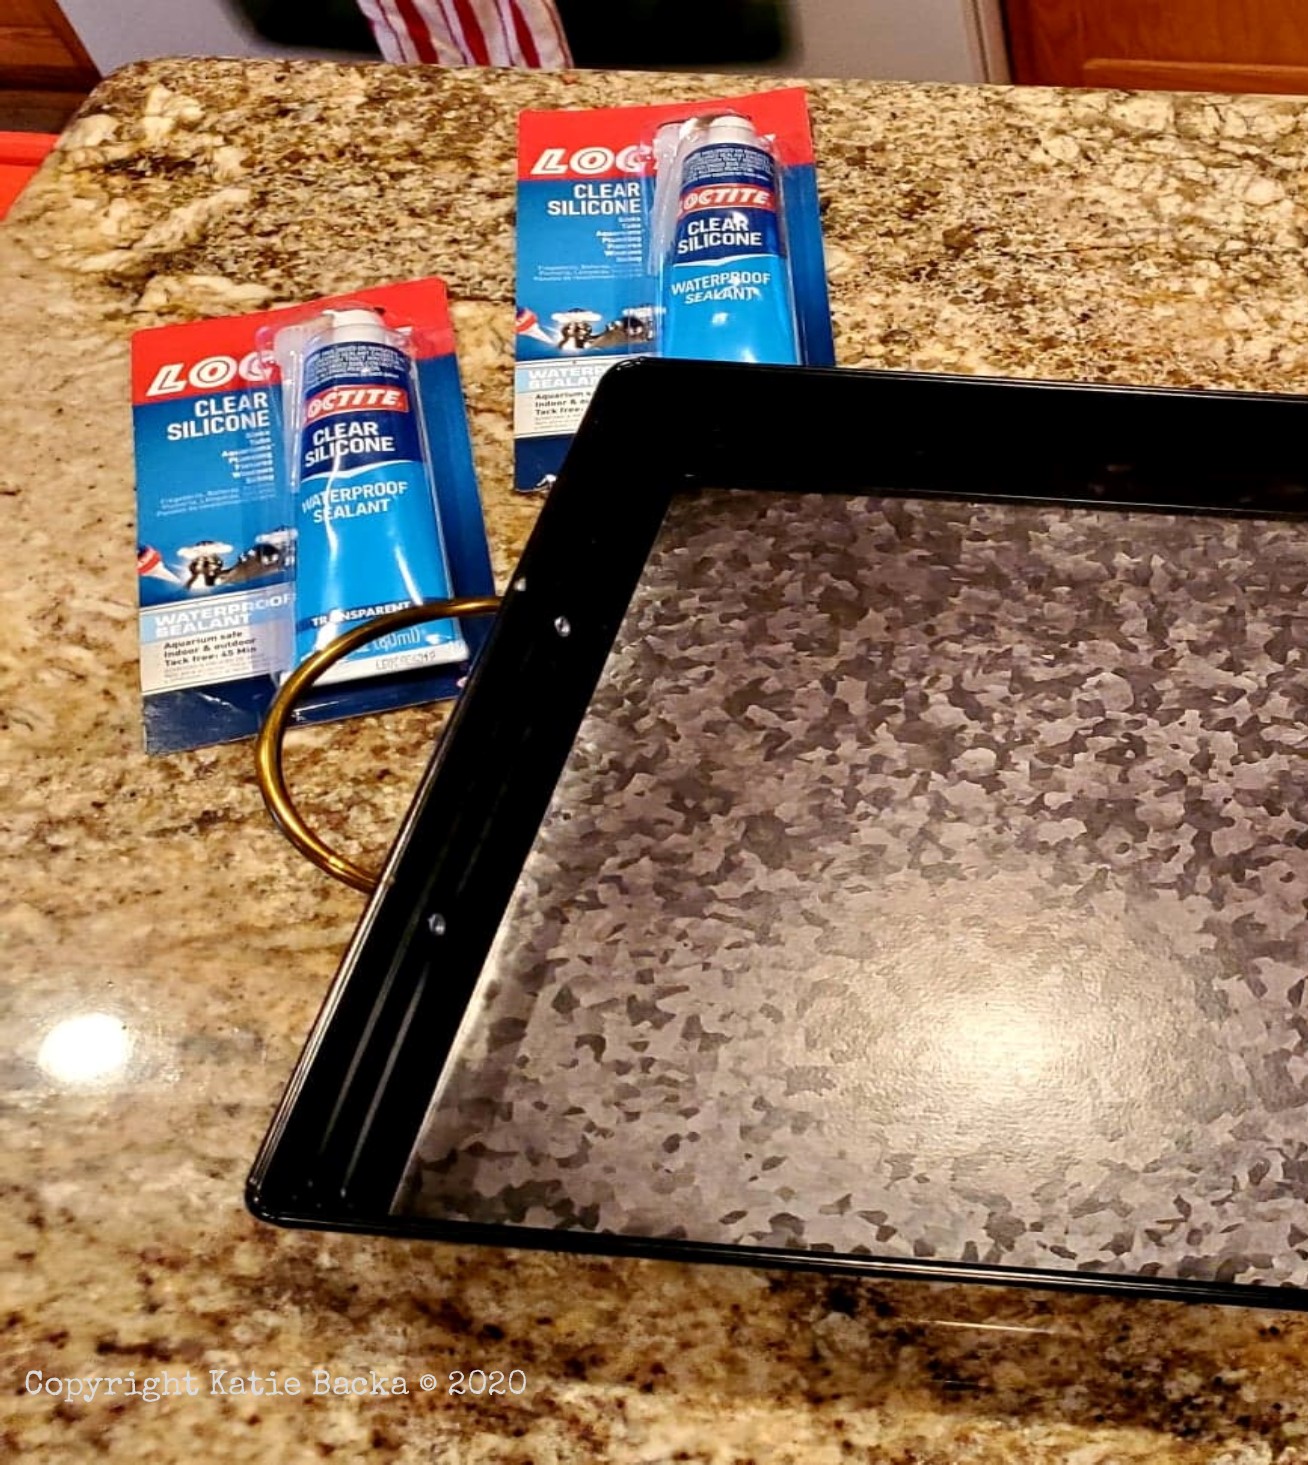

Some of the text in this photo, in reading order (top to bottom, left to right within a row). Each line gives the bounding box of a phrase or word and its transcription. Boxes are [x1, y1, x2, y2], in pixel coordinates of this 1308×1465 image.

[530, 145, 654, 175] LOC
[573, 182, 641, 199] CLEAR
[682, 187, 770, 210] OCTITE
[547, 199, 642, 216] SILICONE
[687, 215, 750, 236] CLEAR
[677, 231, 763, 255] SILICONE
[671, 271, 771, 295] WATERPROOF
[685, 285, 759, 304] SEALANT
[145, 351, 275, 397] LOC
[194, 392, 269, 418] CLEAR
[306, 388, 401, 418] OCTITE
[166, 409, 271, 441] SILICONE
[312, 421, 380, 447] CLEAR
[304, 436, 396, 468] SILICONE
[302, 481, 408, 513] WATERPROOF
[313, 499, 391, 524] SEALANT
[311, 600, 412, 627] TRNSPARENT
